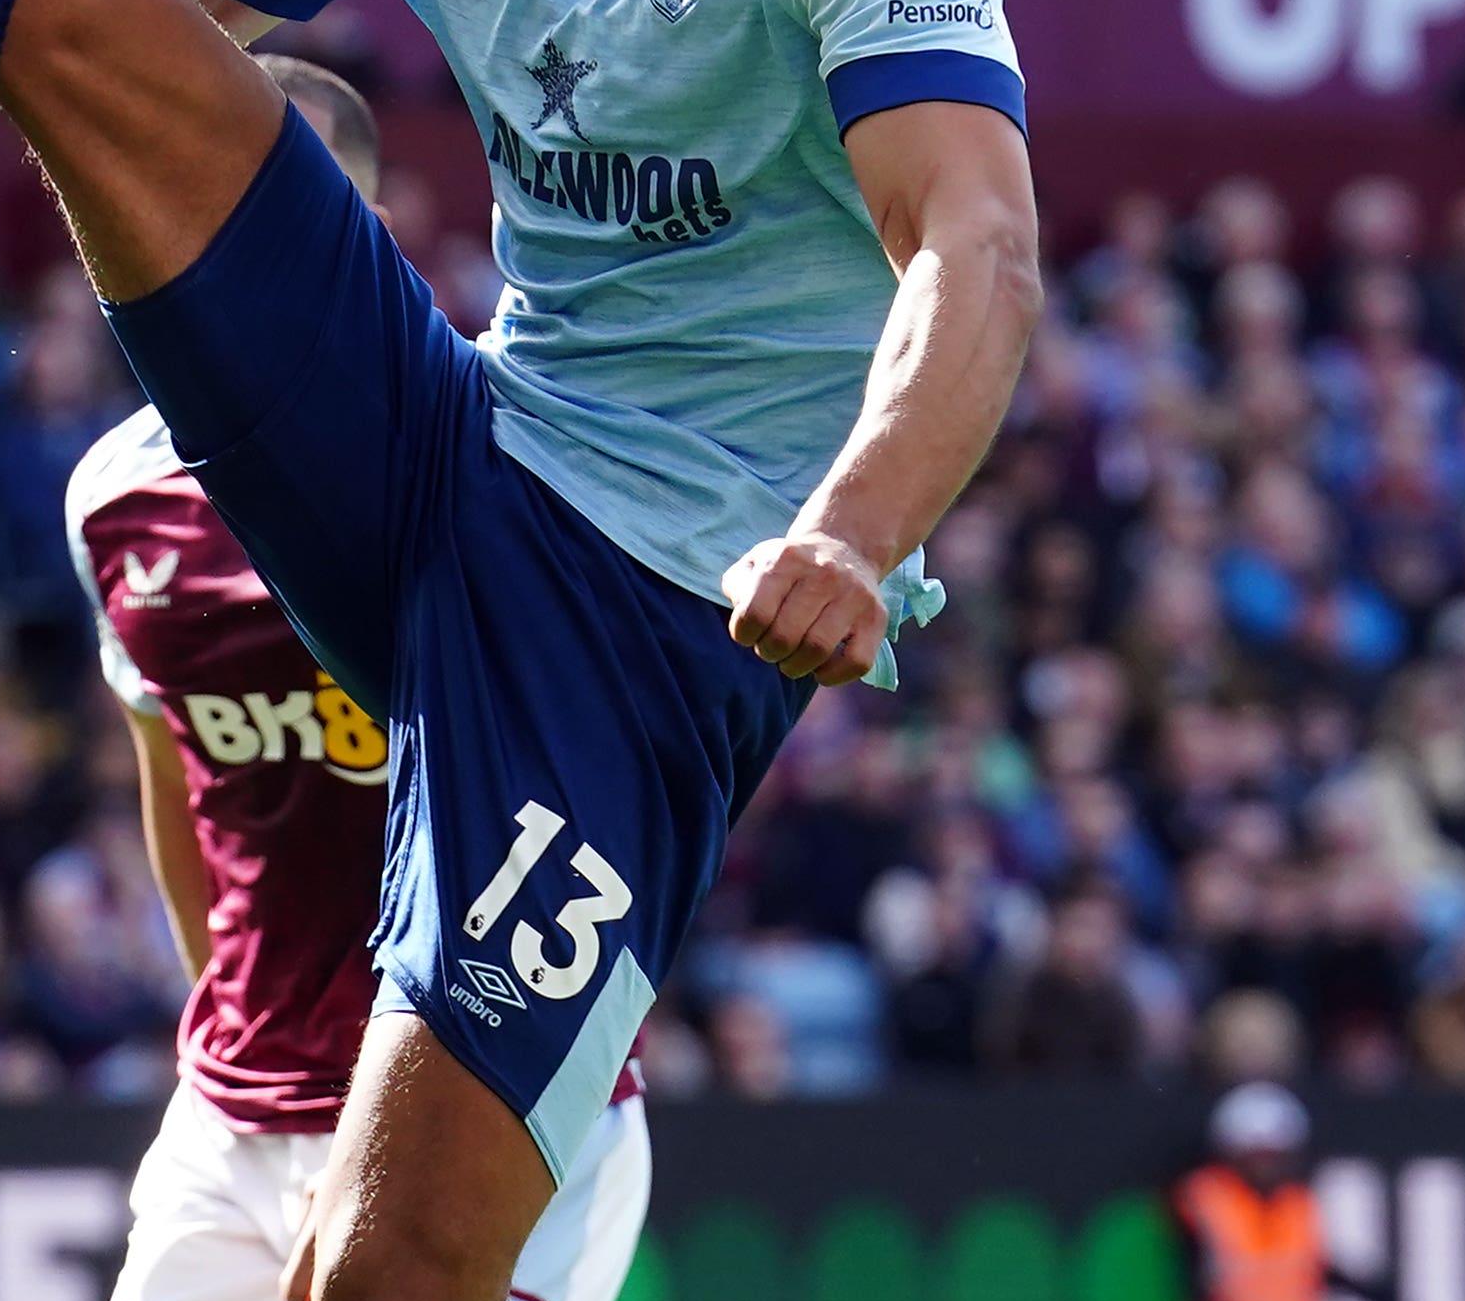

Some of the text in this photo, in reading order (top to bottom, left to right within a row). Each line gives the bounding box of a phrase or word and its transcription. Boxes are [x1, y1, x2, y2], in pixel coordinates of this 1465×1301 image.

[183, 688, 388, 772] BK8
[462, 799, 633, 1000] 13
[448, 981, 502, 1029] umbro
